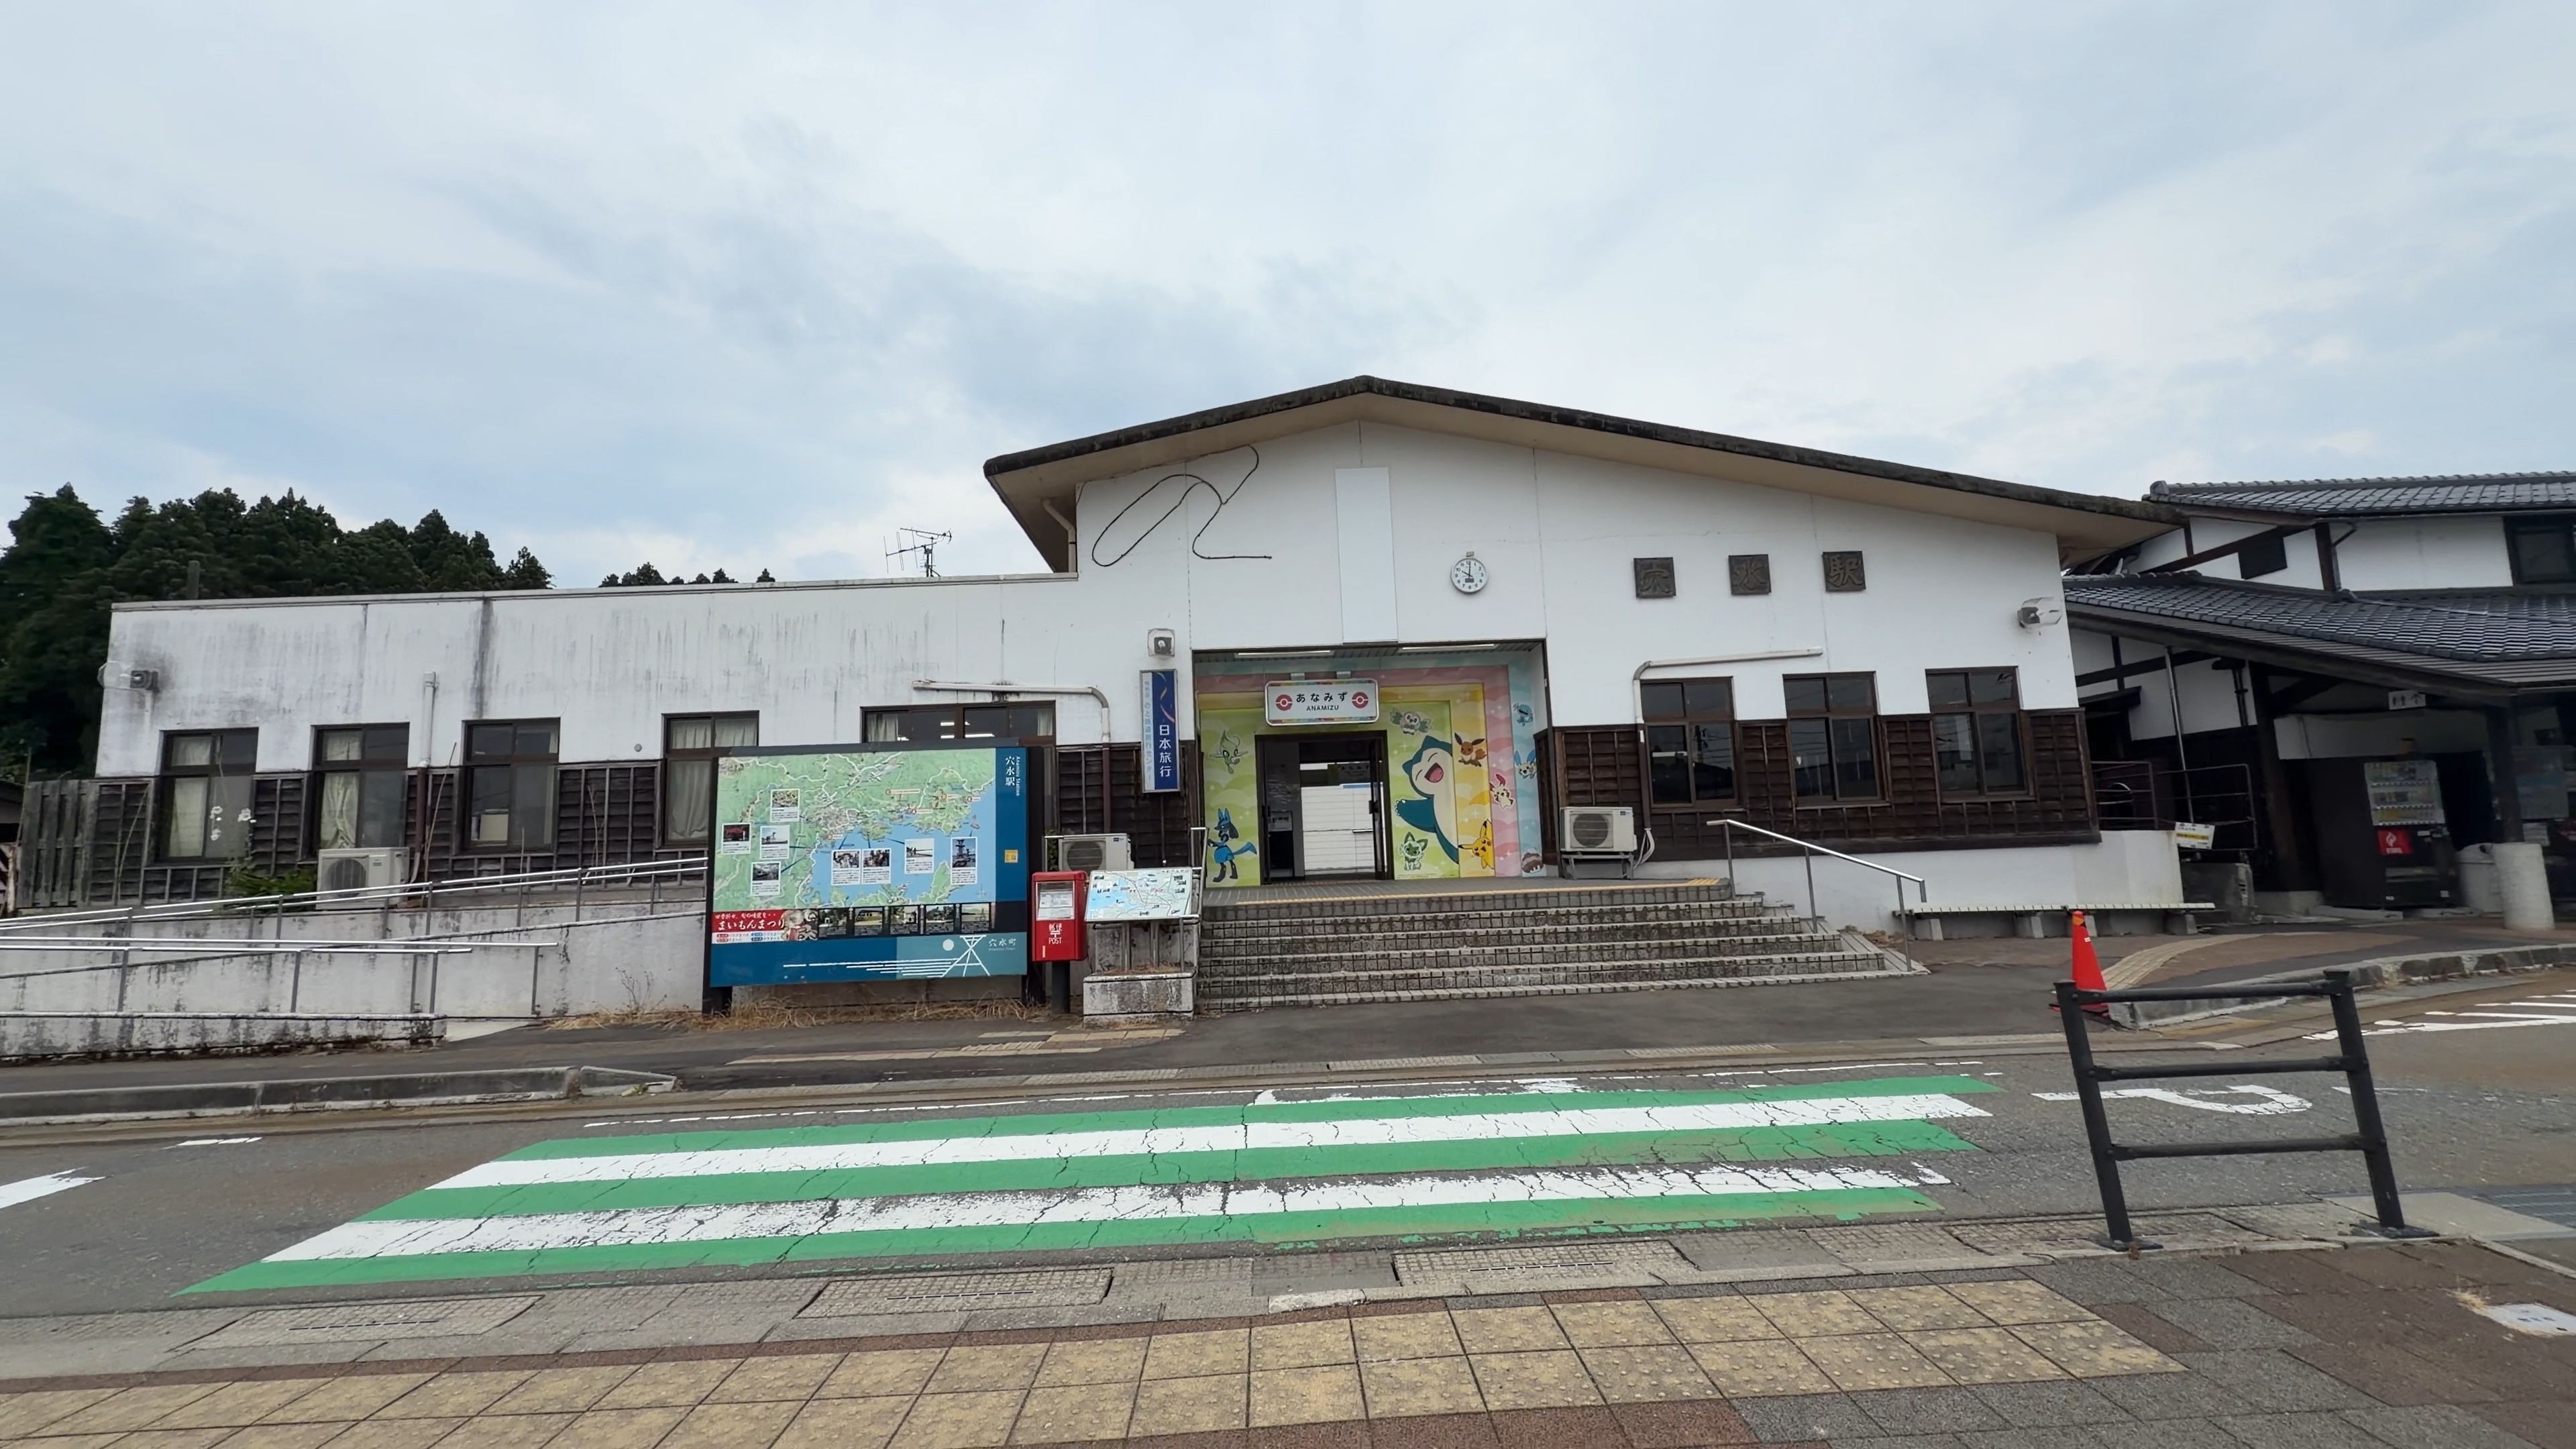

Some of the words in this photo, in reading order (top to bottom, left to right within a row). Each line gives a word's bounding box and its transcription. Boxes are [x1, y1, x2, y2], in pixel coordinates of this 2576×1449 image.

[1296, 692, 1348, 704] あなみず
[1159, 724, 1172, 777] 日本旅行
[1005, 755, 1015, 786] 穴水駅
[718, 918, 785, 931] まいもんまつり
[988, 938, 1016, 947] 穴水町
